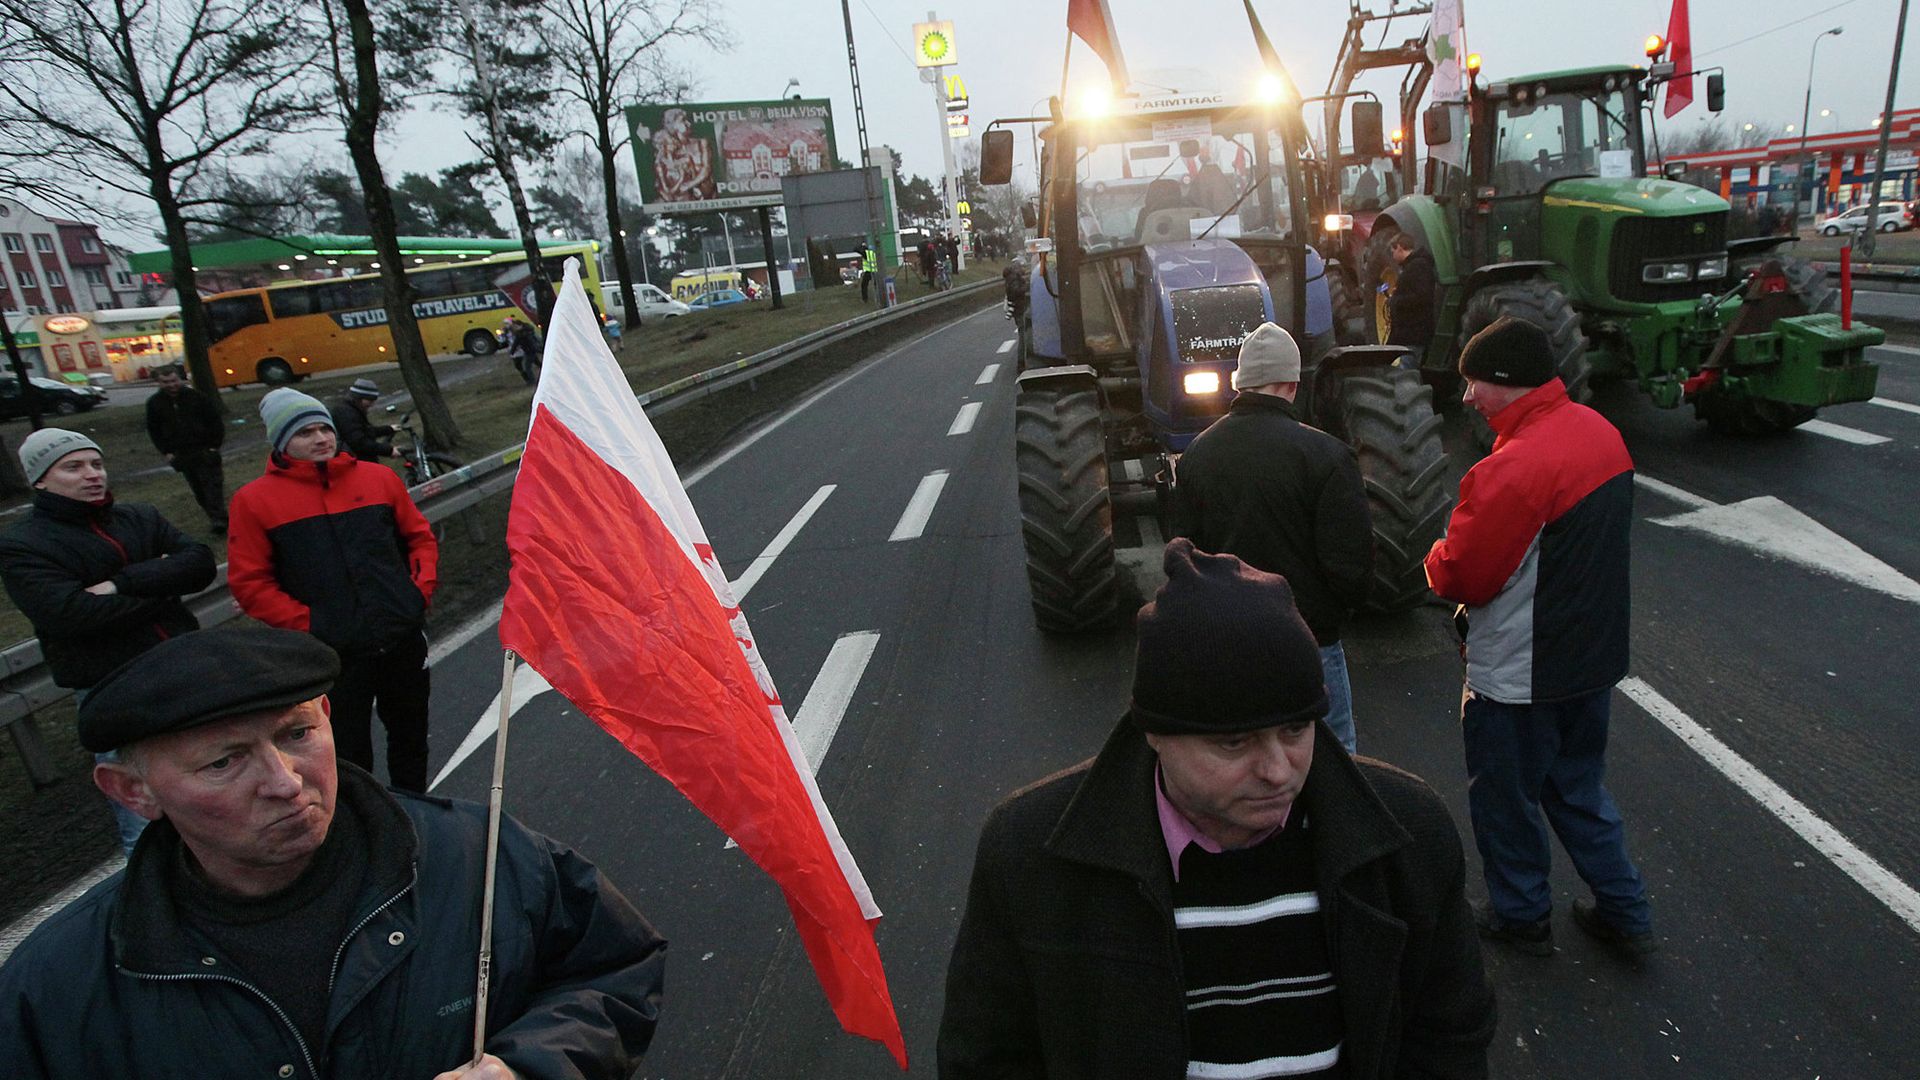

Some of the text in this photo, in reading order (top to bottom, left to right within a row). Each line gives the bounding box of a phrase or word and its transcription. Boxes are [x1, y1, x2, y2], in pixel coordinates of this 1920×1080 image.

[1135, 95, 1224, 109] FARMTRAC
[692, 110, 747, 123] HOTEL
[767, 106, 798, 119] BELLA
[799, 106, 829, 118] VISTA
[1190, 337, 1244, 350] FARMTRA
